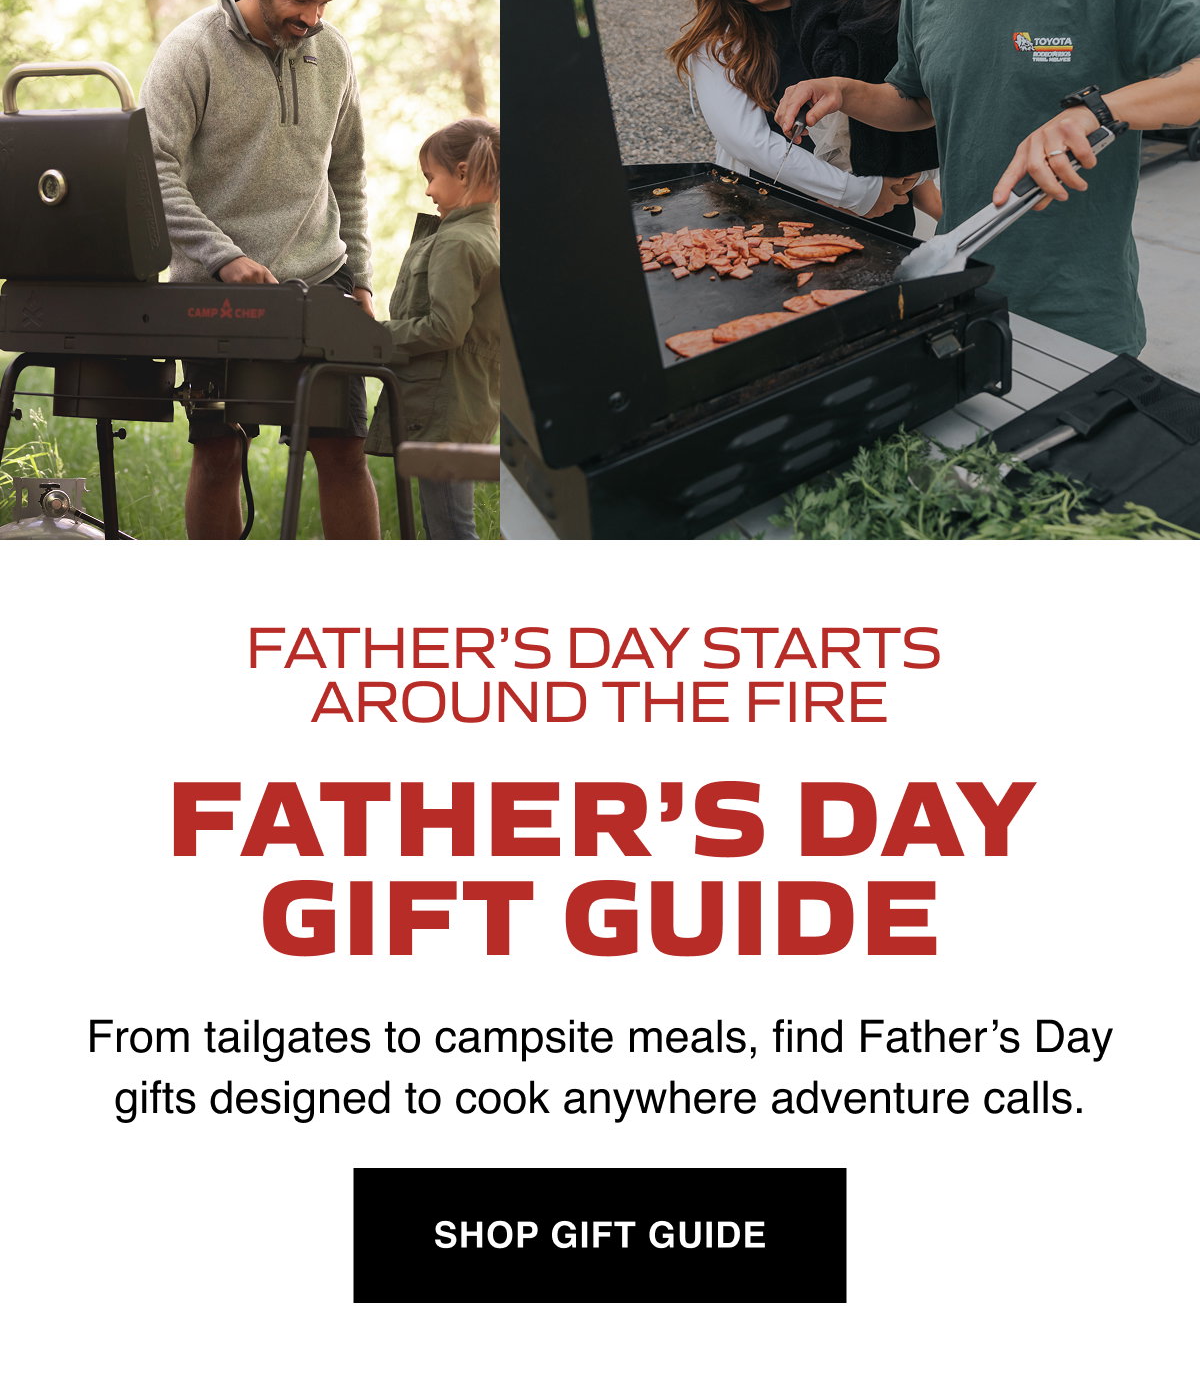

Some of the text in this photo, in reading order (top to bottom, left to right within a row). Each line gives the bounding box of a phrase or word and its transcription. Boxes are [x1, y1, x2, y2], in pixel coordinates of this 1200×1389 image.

[1034, 37, 1072, 46] TOYOTA
[187, 307, 266, 319] CAMP CHEF
